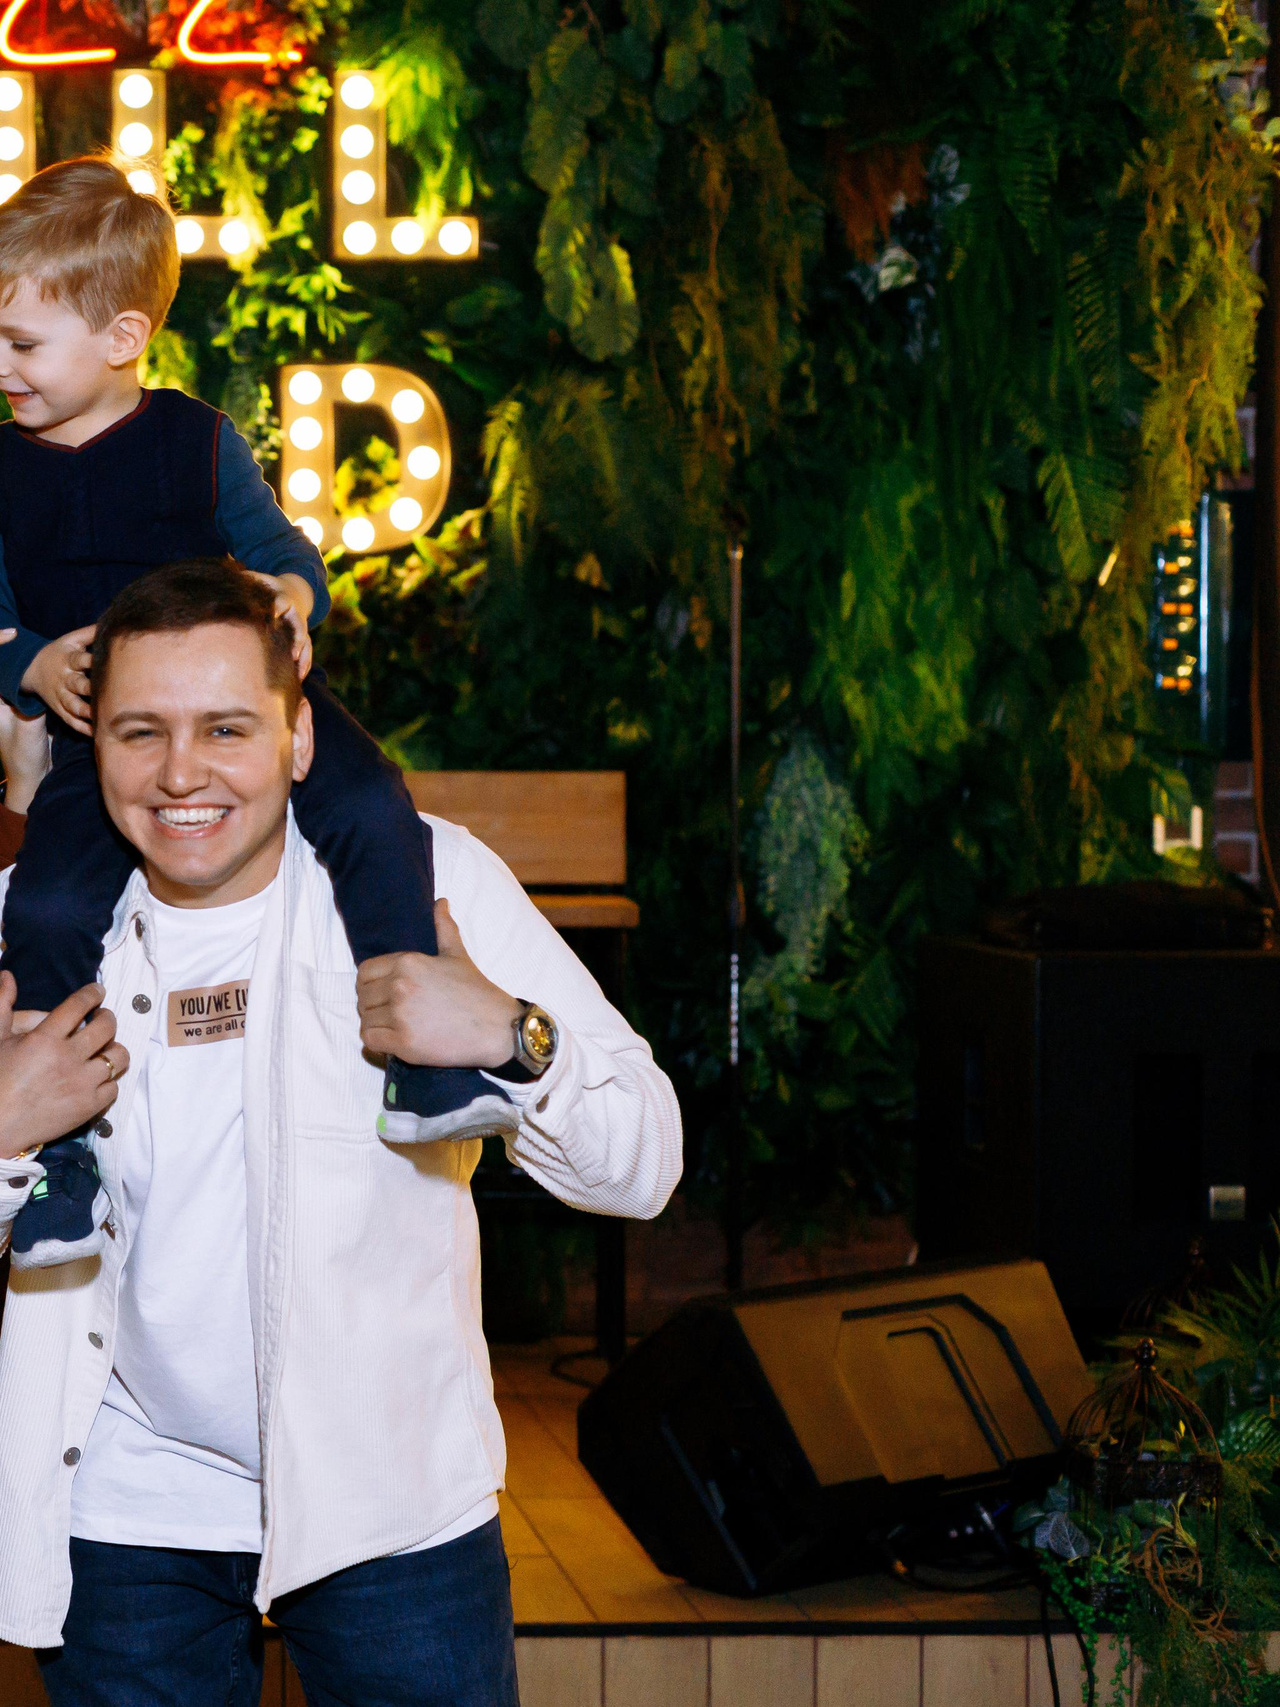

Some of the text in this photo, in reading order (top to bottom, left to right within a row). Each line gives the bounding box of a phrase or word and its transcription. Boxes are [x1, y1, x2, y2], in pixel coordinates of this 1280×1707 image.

[180, 991, 231, 1017] YOU/WE
[184, 1027, 202, 1037] we
[206, 1024, 222, 1035] are
[225, 1019, 238, 1031] all
